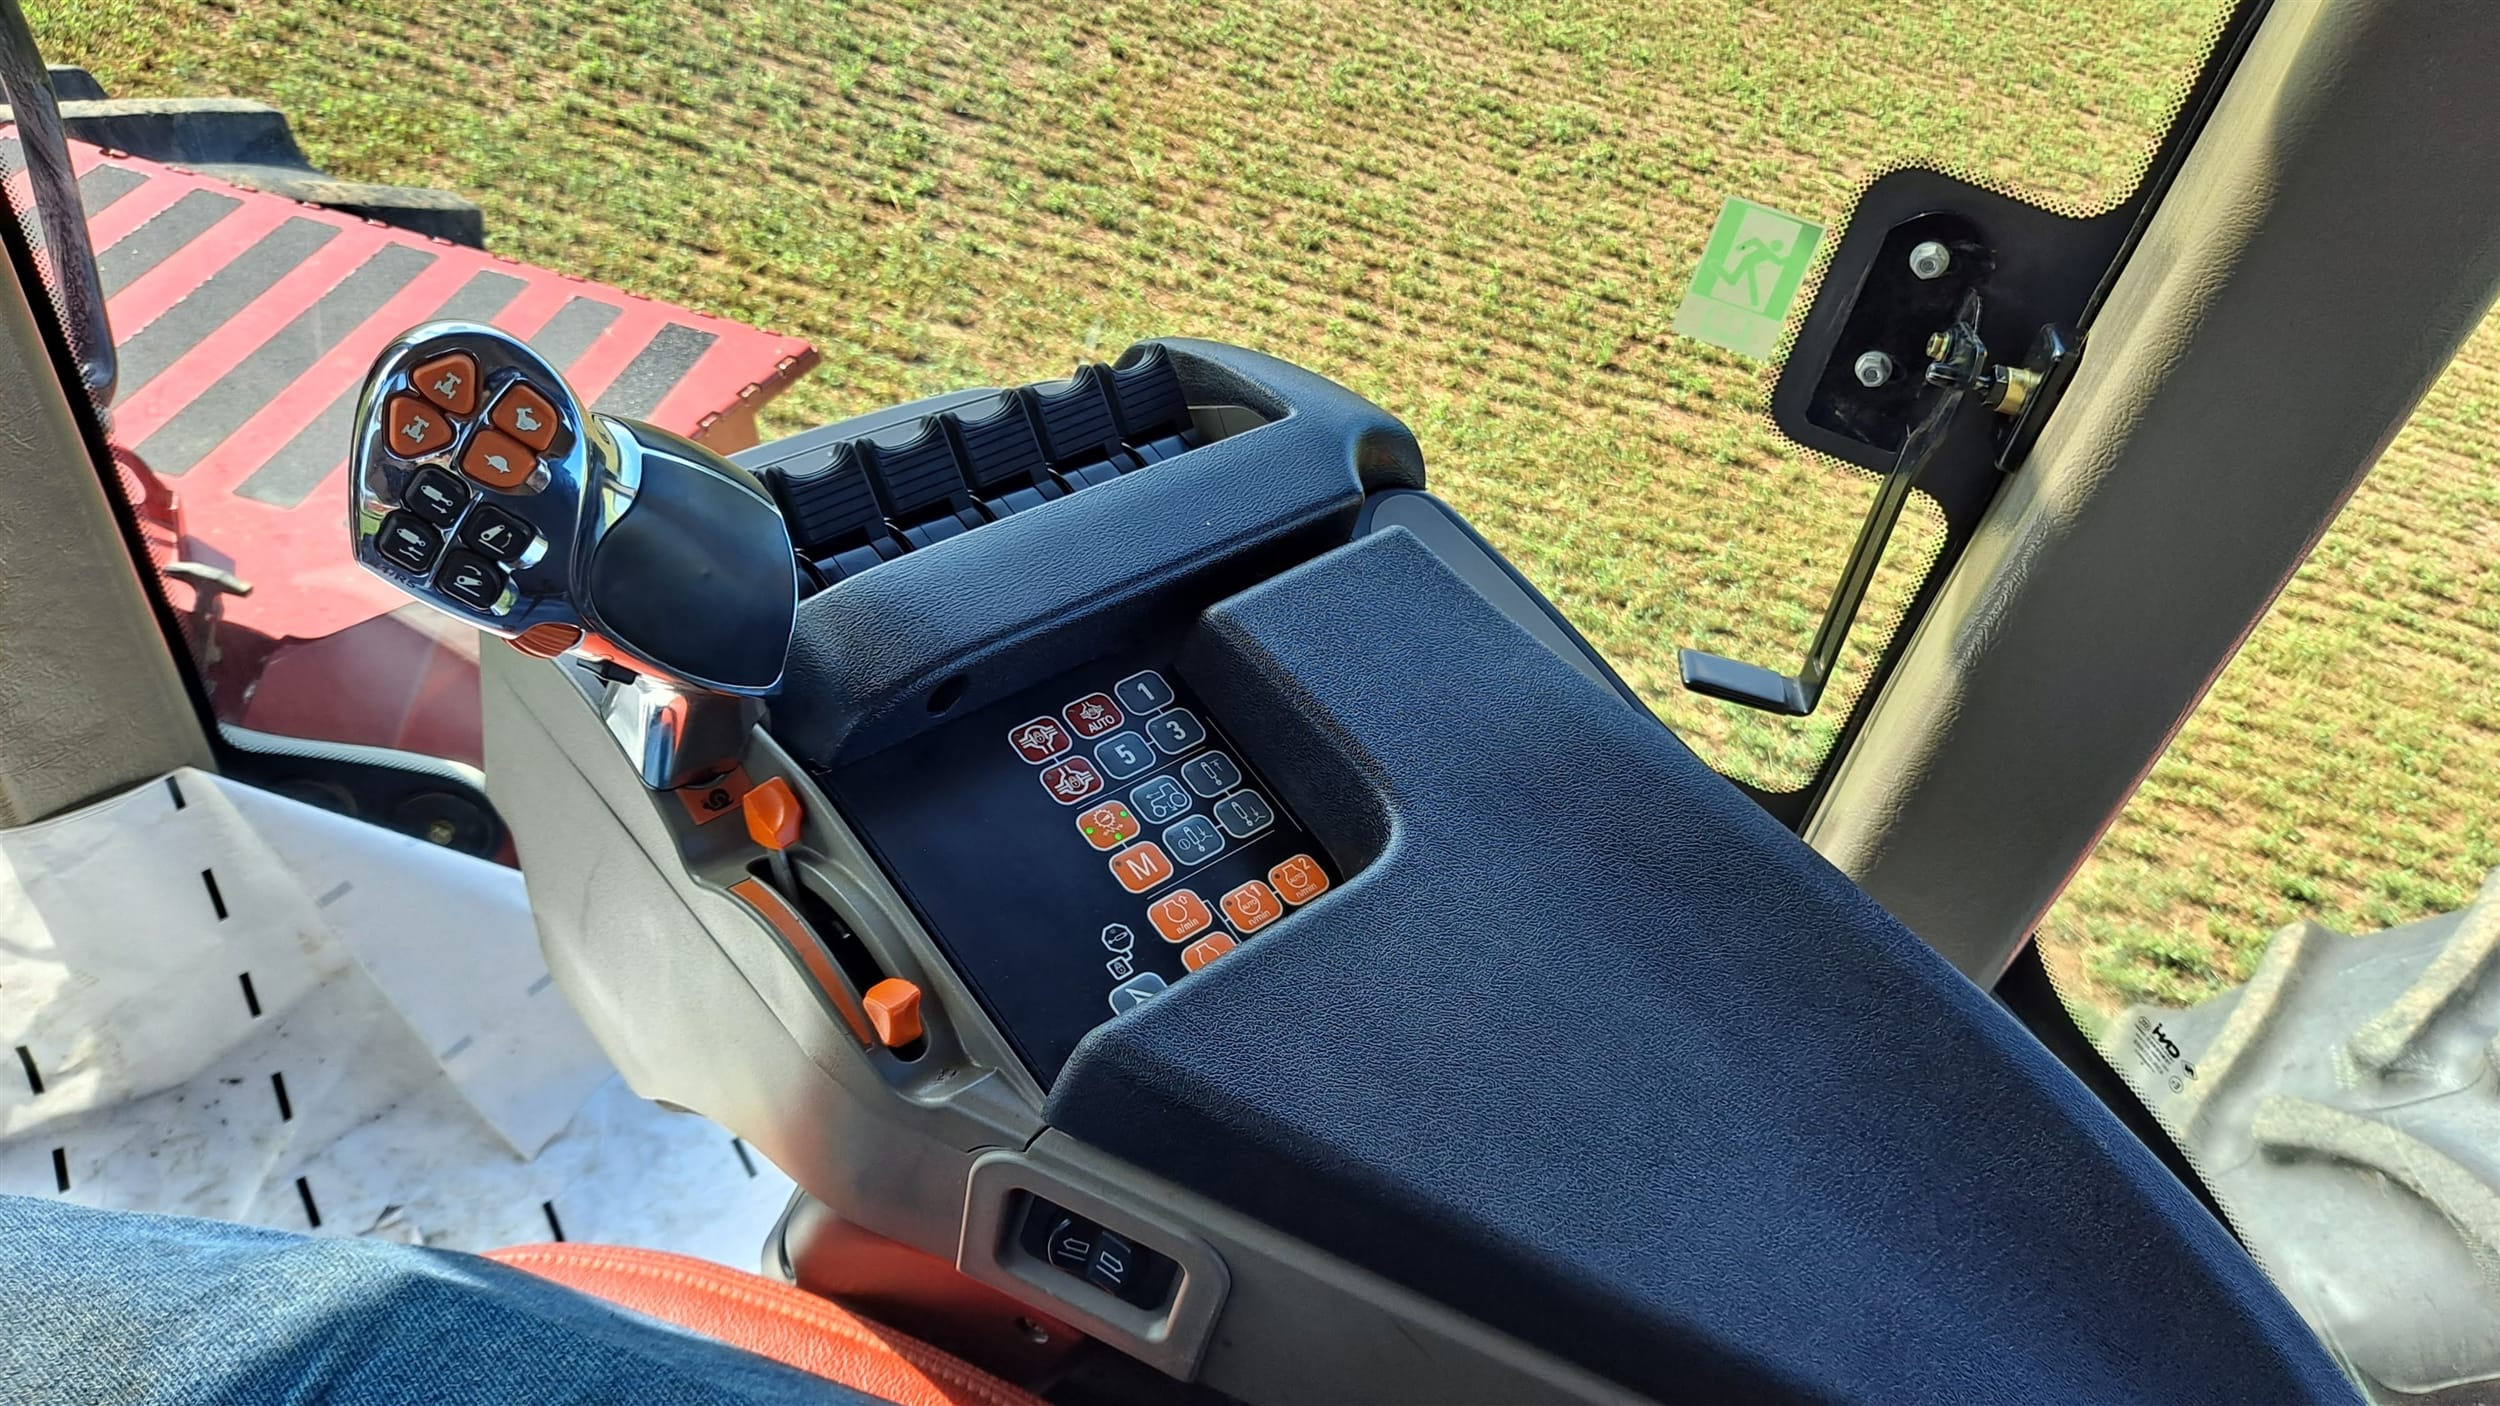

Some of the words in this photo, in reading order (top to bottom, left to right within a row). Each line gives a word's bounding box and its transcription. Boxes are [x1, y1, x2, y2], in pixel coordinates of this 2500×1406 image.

[1137, 682, 1155, 701] 1
[1088, 715, 1115, 733] AUTO
[1166, 720, 1186, 740] 3
[1114, 743, 1136, 765] 5
[1126, 851, 1158, 881] M
[1298, 857, 1311, 870] 2
[1250, 884, 1262, 897] 1
[1175, 917, 1200, 936] n/min
